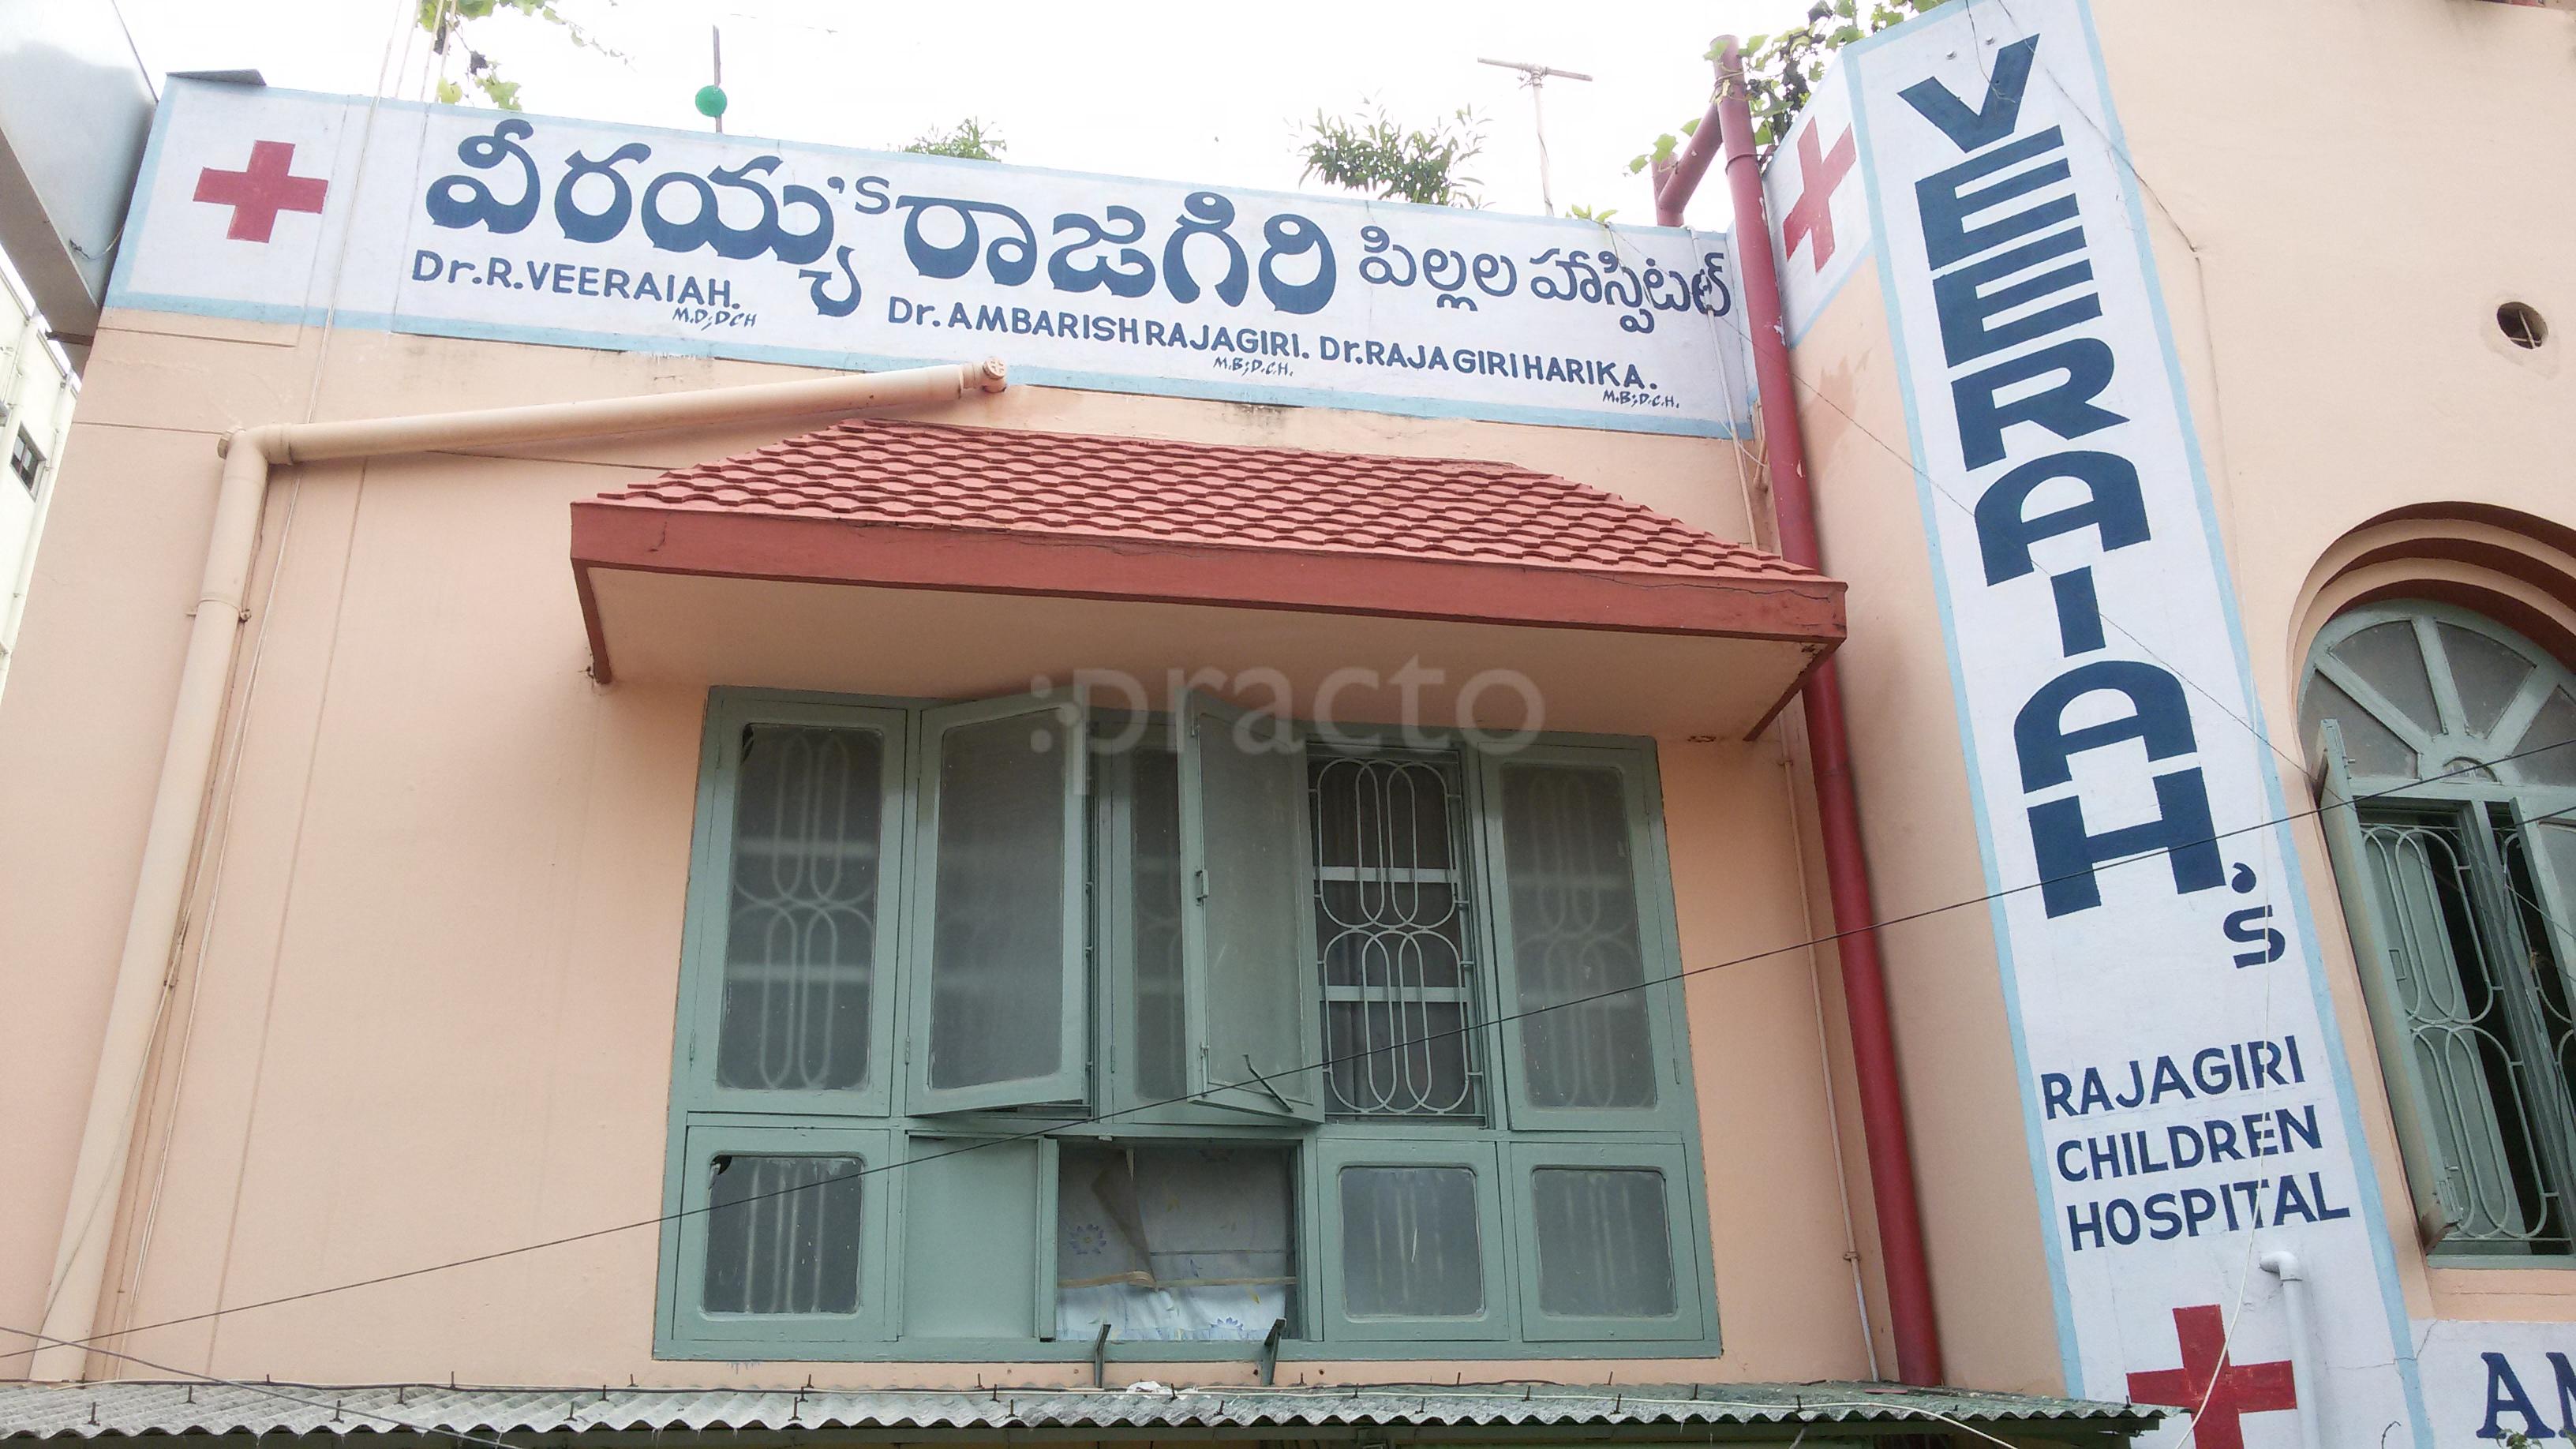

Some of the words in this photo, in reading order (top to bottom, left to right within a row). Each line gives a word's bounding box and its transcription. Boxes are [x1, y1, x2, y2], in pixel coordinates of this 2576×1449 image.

[895, 190, 1337, 316] రాజగిరి
[1358, 225, 1518, 313] పిల్లల
[2040, 1034, 2307, 1120] RAJAGIRI
[2056, 1103, 2323, 1185] CHILDREN
[2065, 1170, 2351, 1252] HOSPITAL
